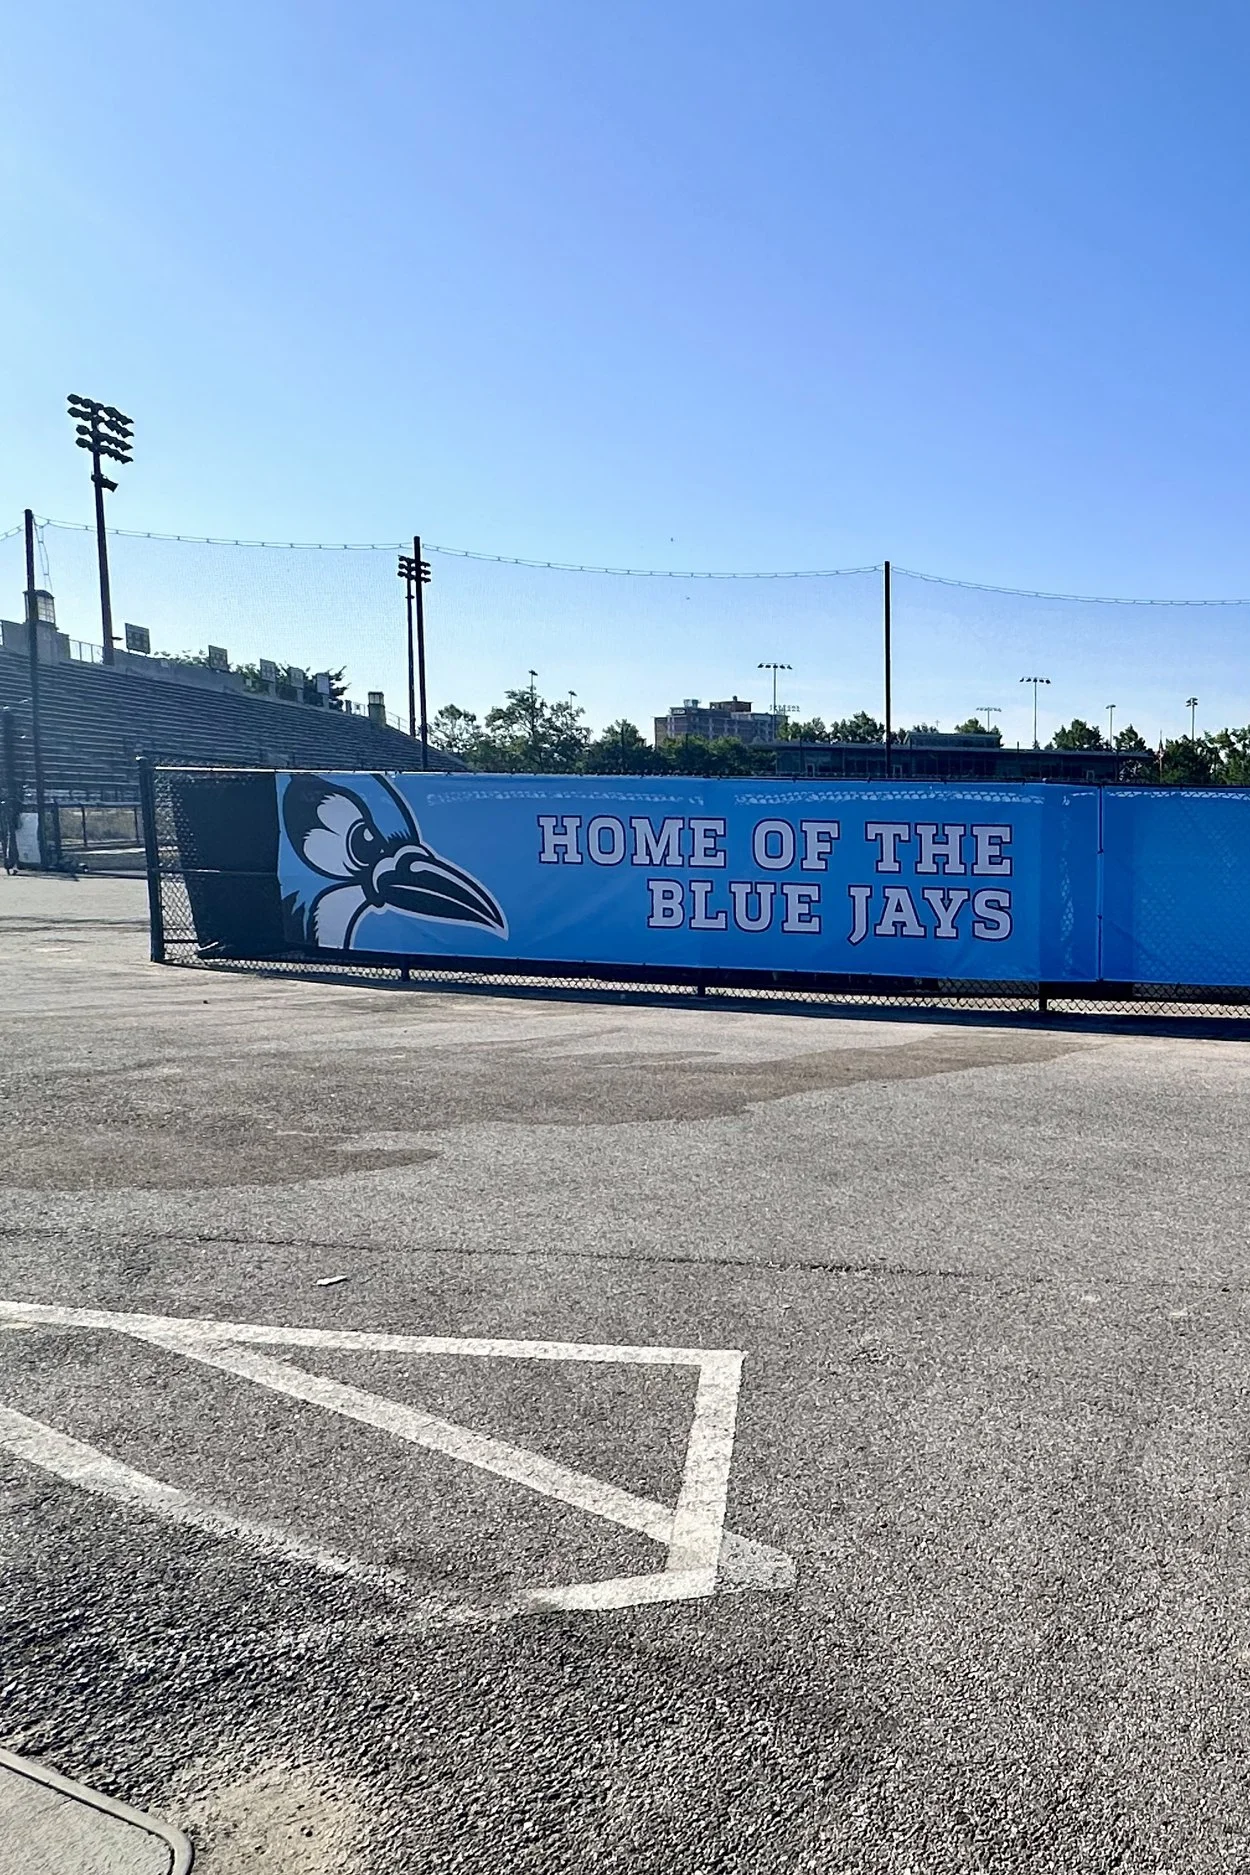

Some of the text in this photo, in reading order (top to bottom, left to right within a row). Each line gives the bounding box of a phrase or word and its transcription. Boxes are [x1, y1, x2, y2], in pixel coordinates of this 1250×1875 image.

[536, 814, 1013, 877] HOME OF THE
[647, 878, 1014, 946] BLUE JAYS
